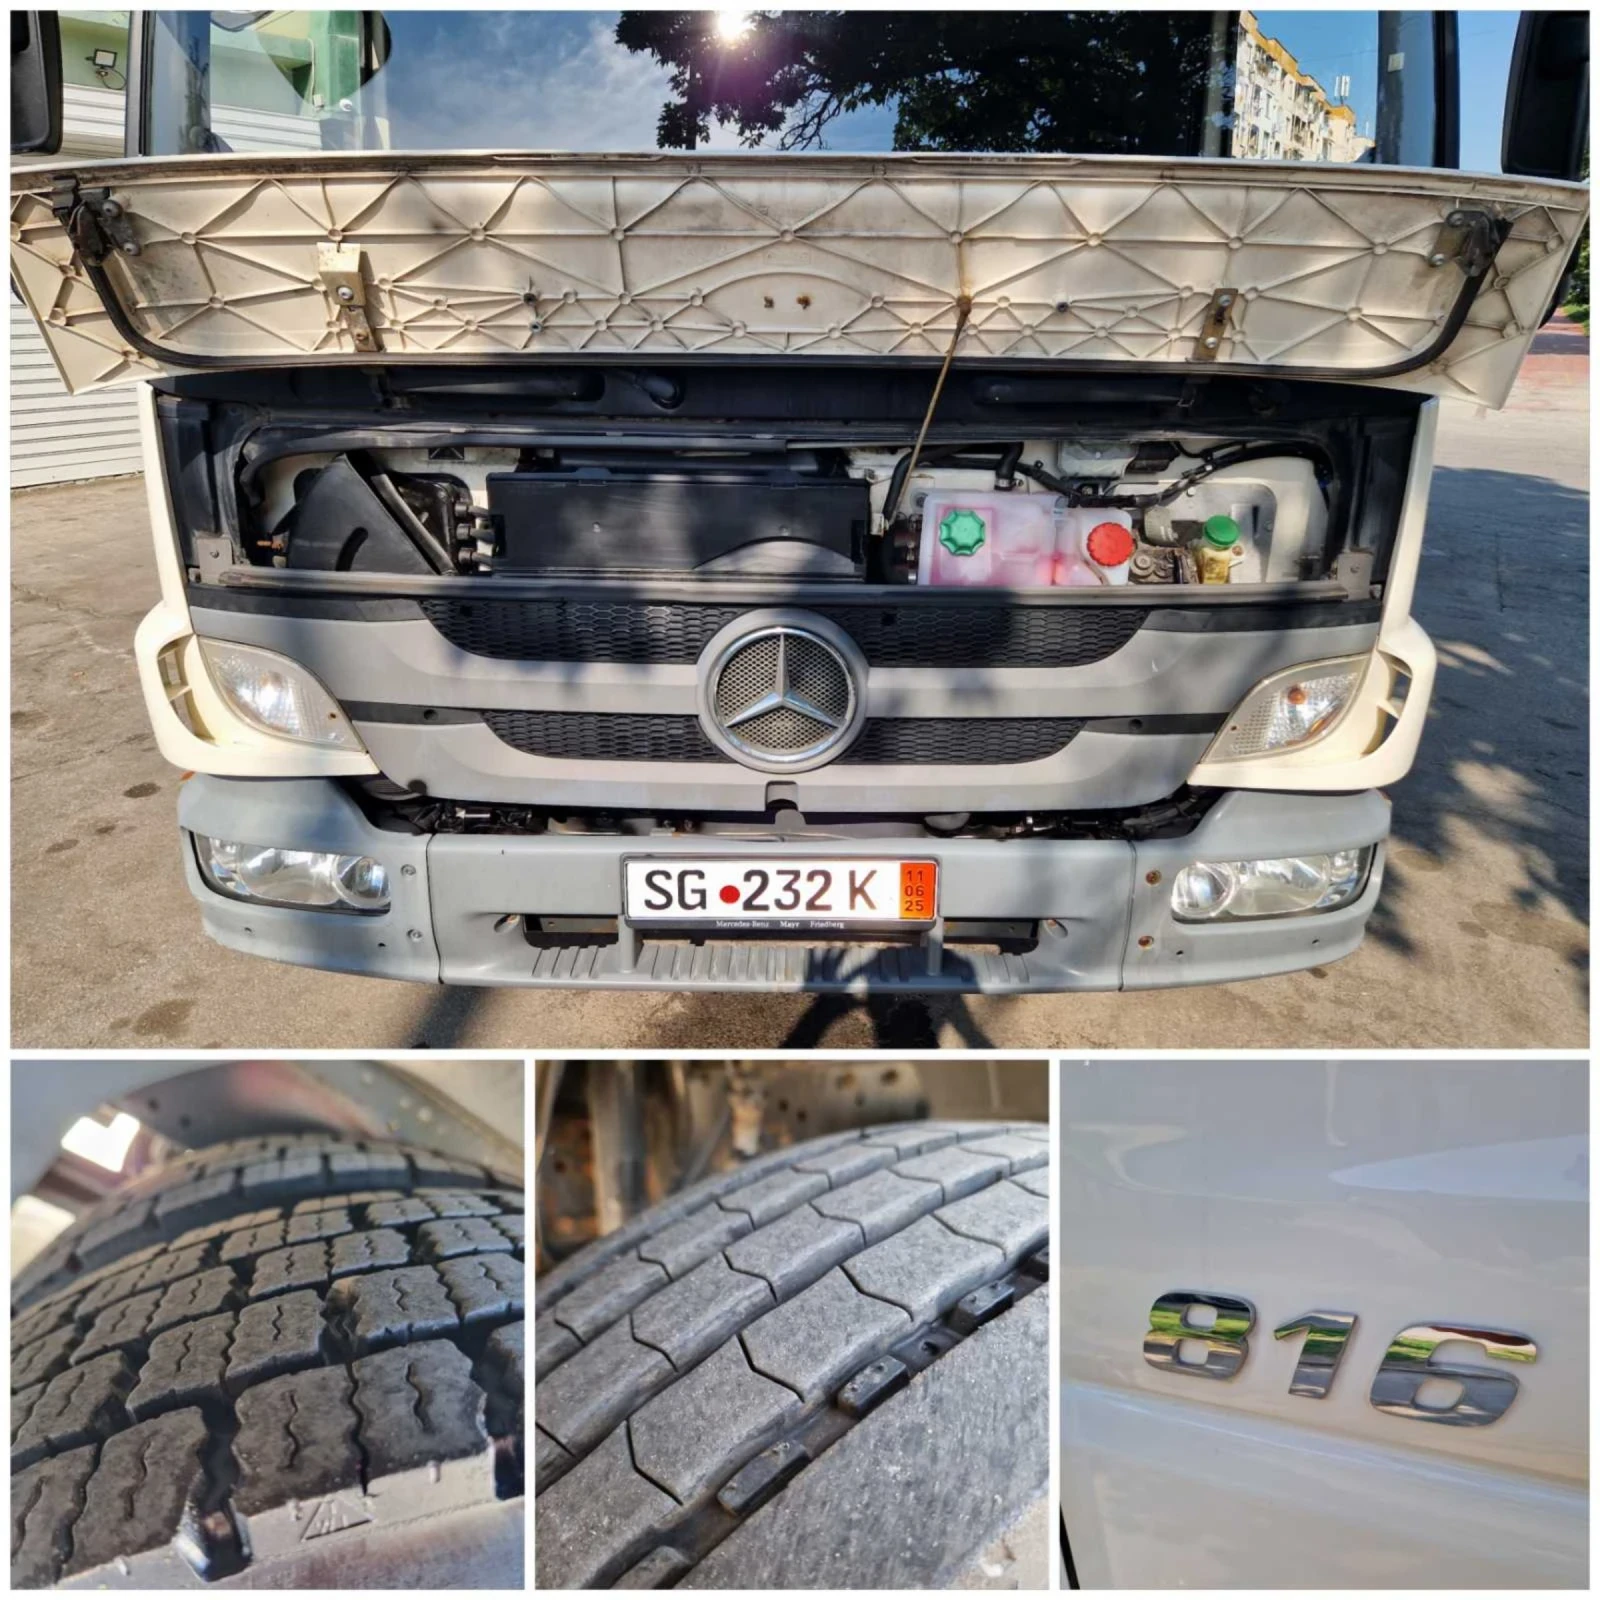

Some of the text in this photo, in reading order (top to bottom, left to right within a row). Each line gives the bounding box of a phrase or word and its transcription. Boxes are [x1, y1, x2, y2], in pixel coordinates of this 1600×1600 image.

[905, 870, 924, 882] 11
[643, 869, 877, 912] SG 232 K
[904, 884, 925, 897] 06
[904, 899, 925, 912] 25
[780, 920, 800, 930] Mayr
[810, 920, 845, 930] Friedberg
[1143, 1289, 1538, 1427] 816
